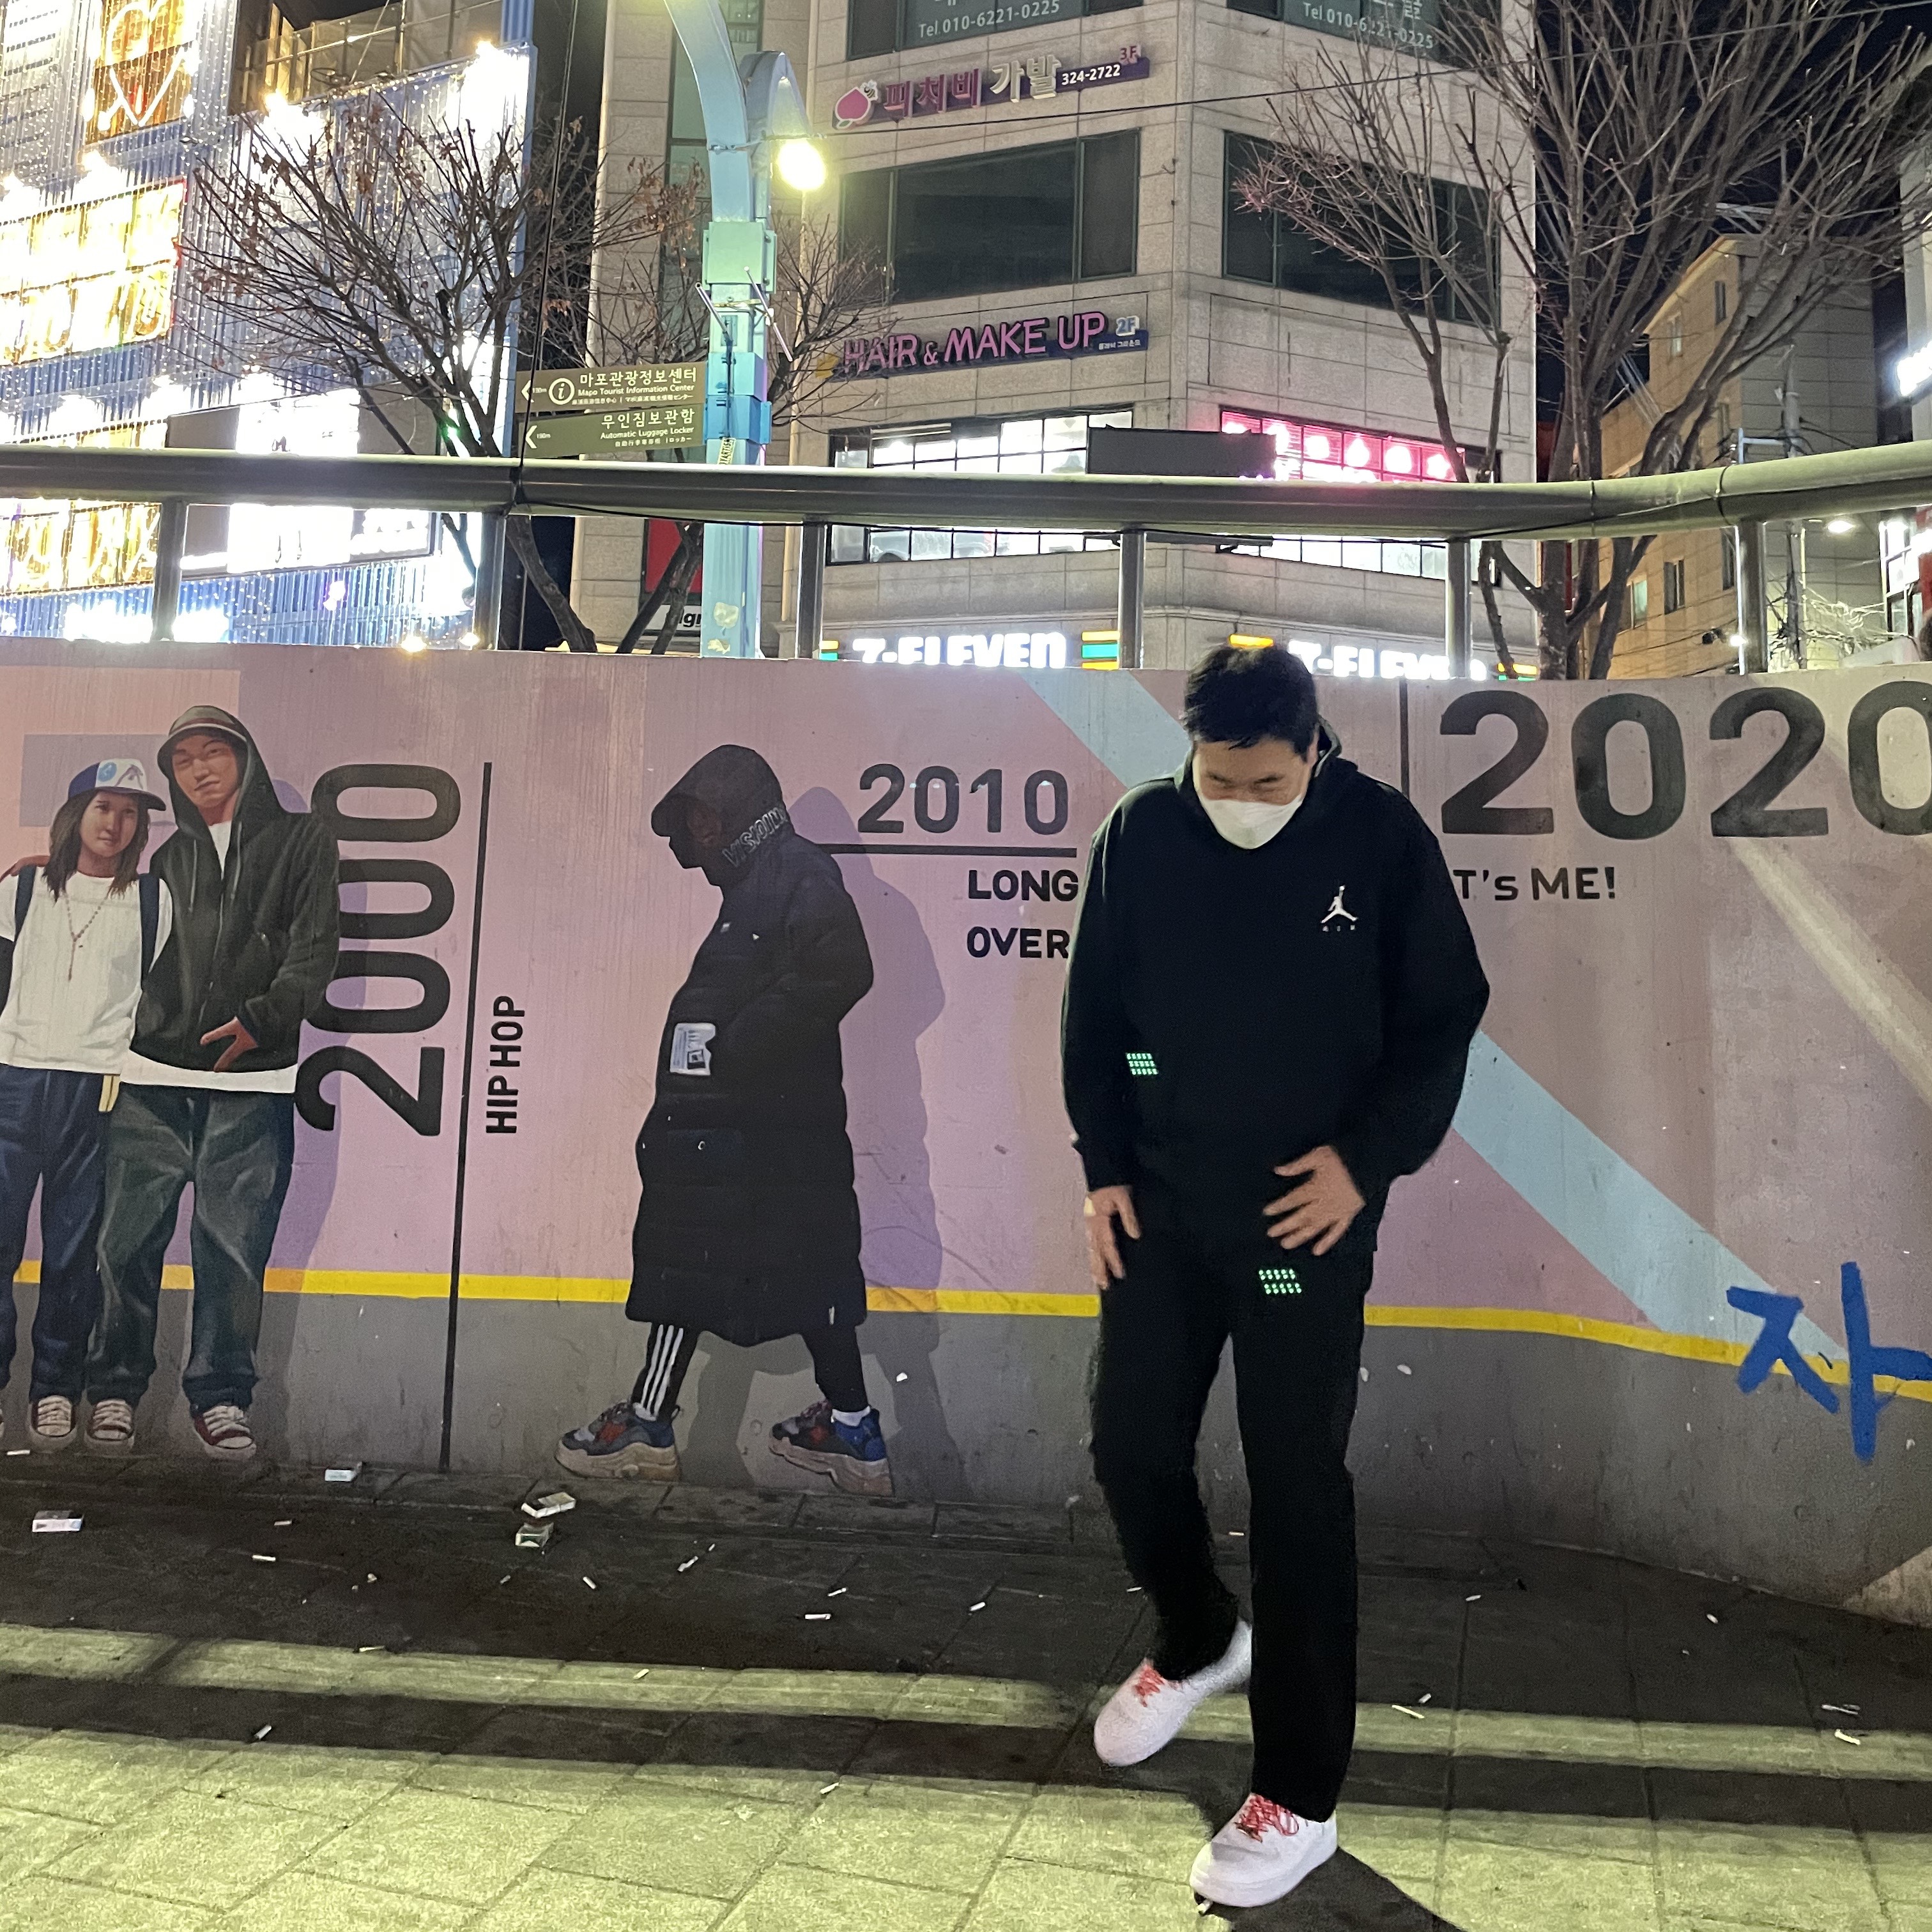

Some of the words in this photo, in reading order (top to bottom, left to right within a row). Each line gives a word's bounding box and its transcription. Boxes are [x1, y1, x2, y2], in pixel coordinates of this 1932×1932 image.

[1120, 45, 1138, 61] 3F
[884, 68, 982, 118] 피치비
[990, 54, 1062, 102] 가발
[1062, 65, 1121, 86] 324-2722
[1059, 312, 1106, 351] UP
[1117, 316, 1138, 335] 2F
[578, 389, 598, 397] Mapo
[626, 385, 668, 394] Information
[579, 367, 697, 388] 마포관광정보센터
[600, 430, 637, 440] Automatic
[638, 429, 668, 438] Luggage
[670, 426, 694, 434] Locker
[601, 408, 695, 429] 무인짐보관함
[1439, 680, 1932, 840] 2020
[857, 763, 1069, 836] 2010
[968, 869, 1079, 902] LONG
[1531, 866, 1615, 901] ME!
[294, 763, 461, 1137] 2000
[967, 926, 1070, 959] OVER
[489, 995, 526, 1068] HOP
[486, 1074, 519, 1134] HIP
